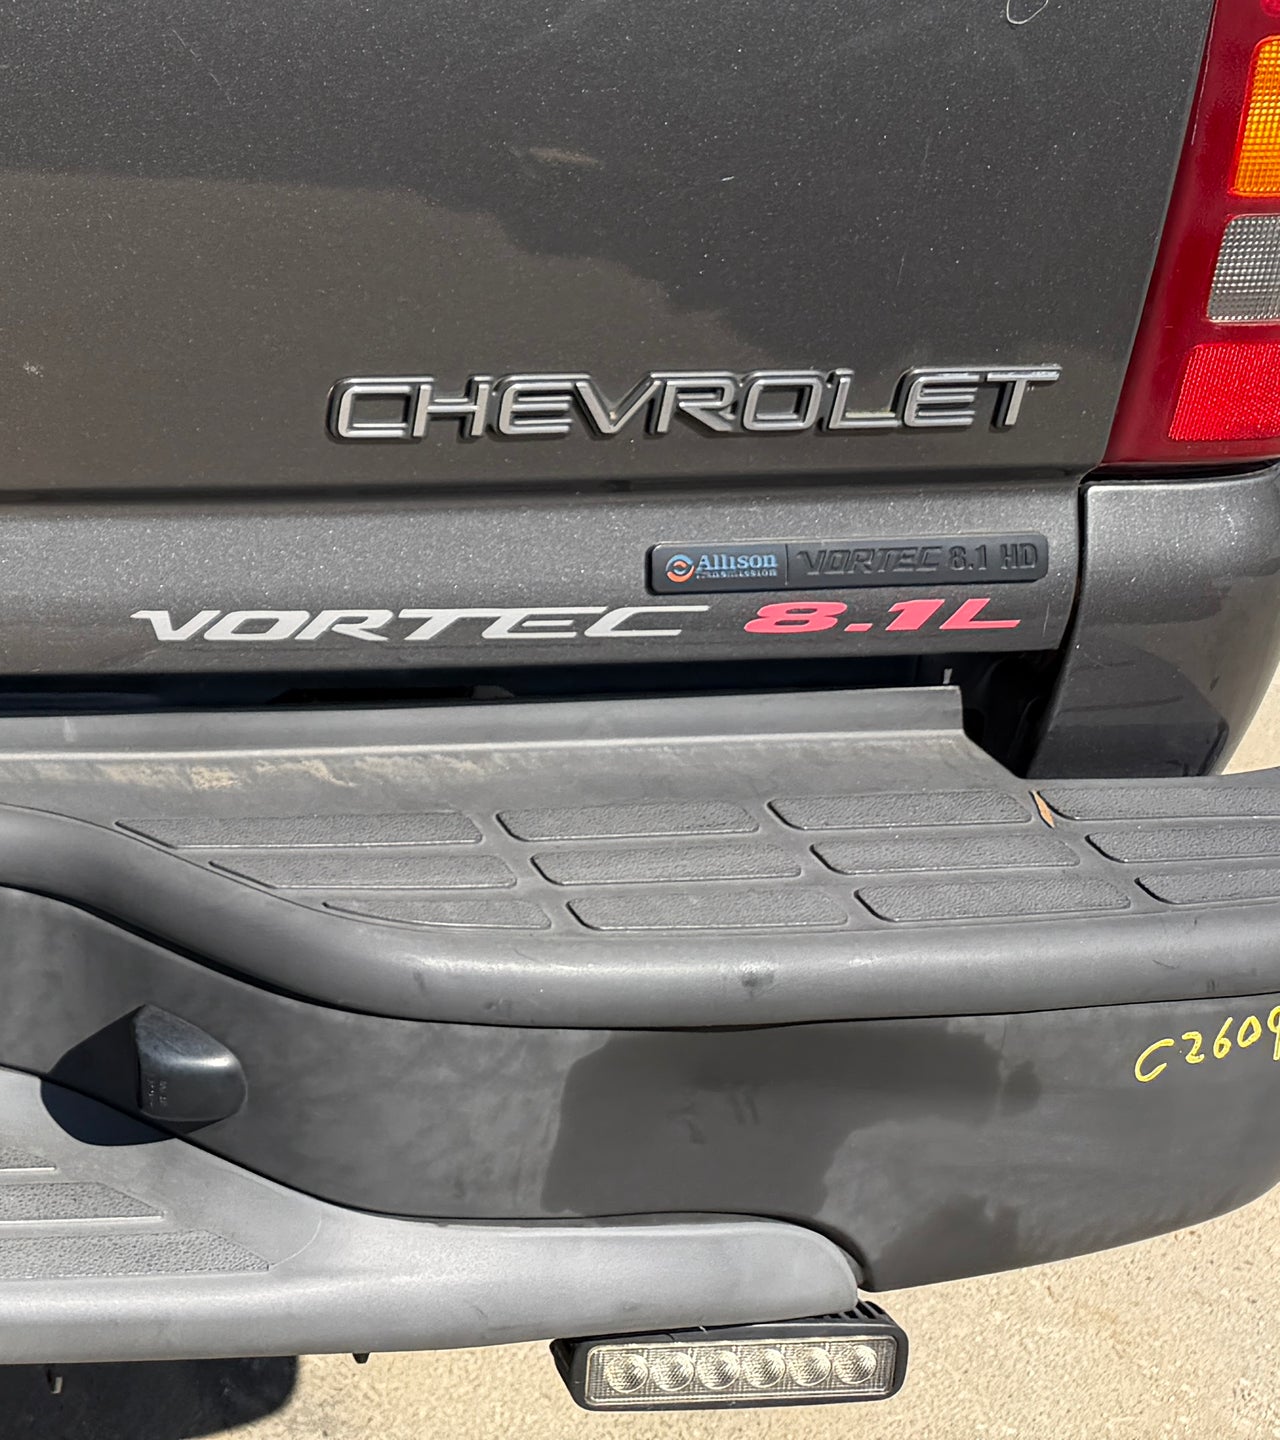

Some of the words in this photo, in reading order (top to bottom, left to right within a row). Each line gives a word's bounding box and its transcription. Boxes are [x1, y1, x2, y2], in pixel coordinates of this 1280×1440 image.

[330, 365, 1062, 444] CHEVROLET
[696, 554, 778, 572] Allison
[796, 546, 943, 576] VORTEC
[948, 544, 988, 572] 8.1
[1000, 543, 1038, 571] HD
[131, 605, 710, 642] VORTEC
[743, 597, 1022, 635] 8.1L
